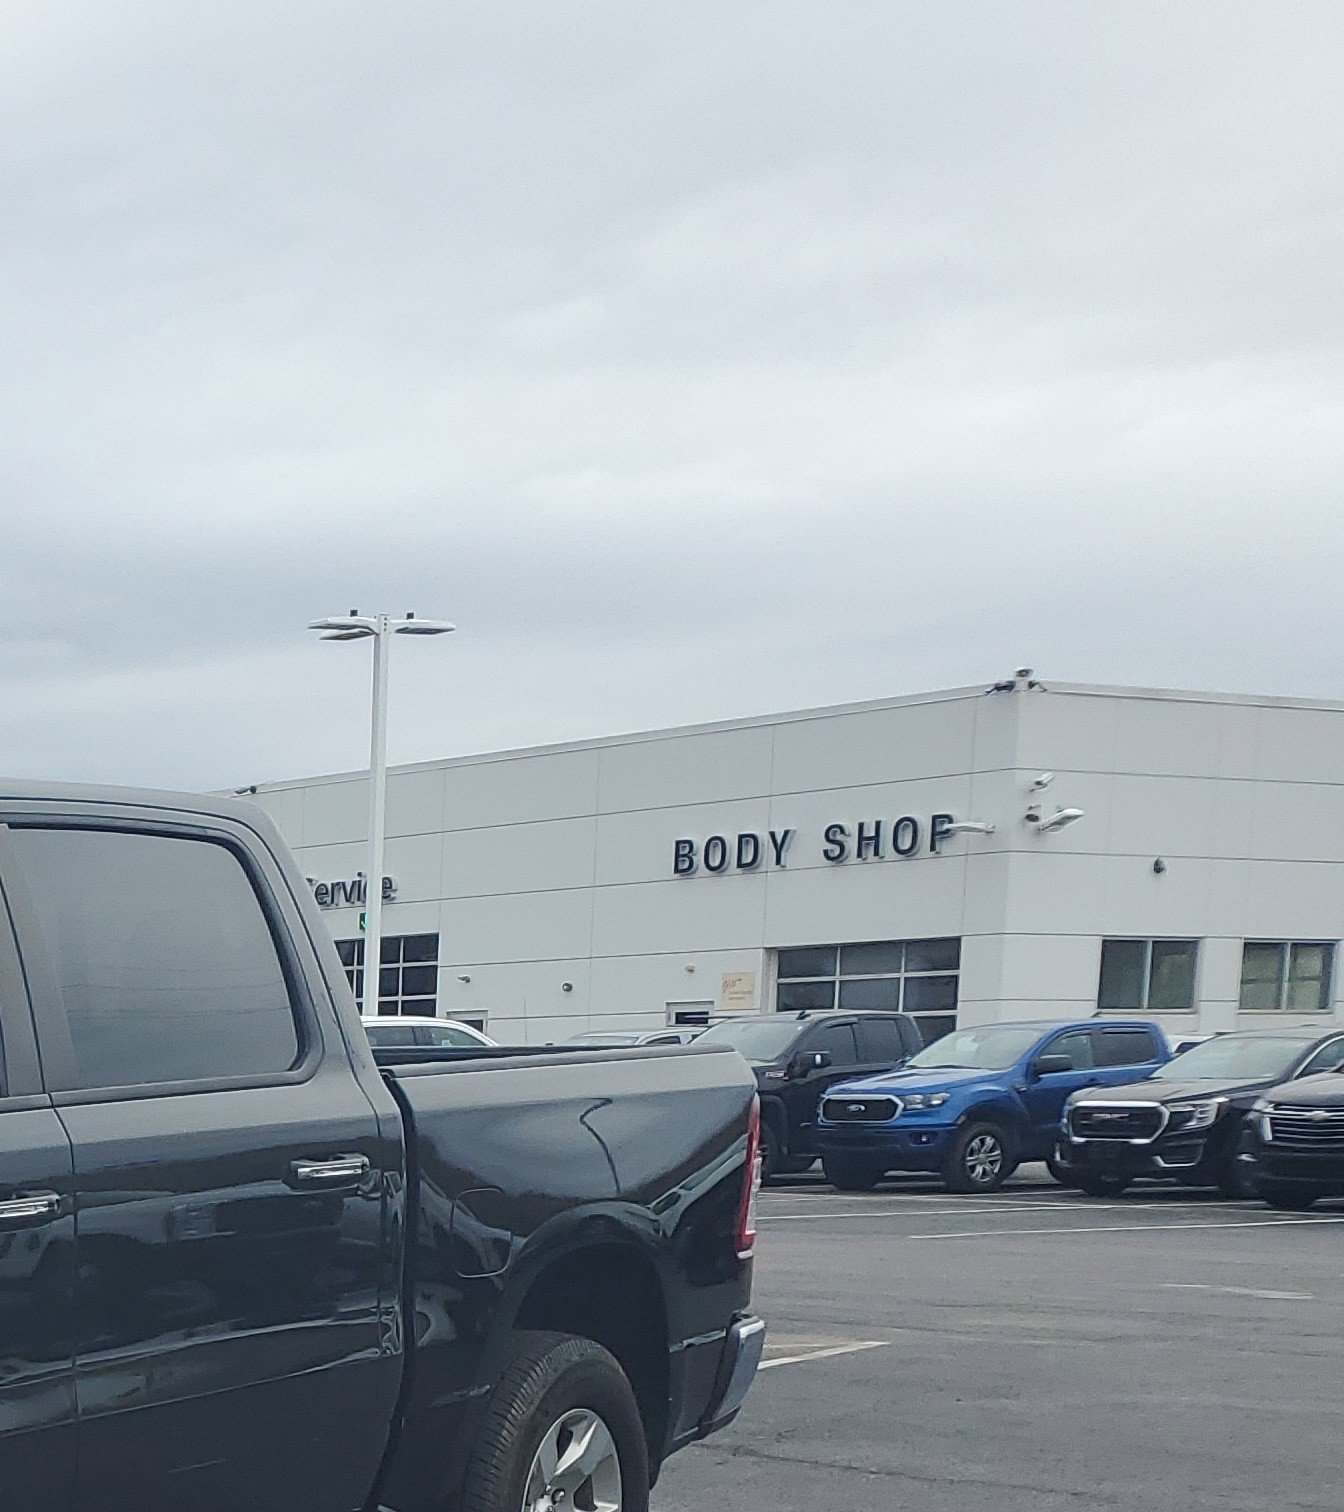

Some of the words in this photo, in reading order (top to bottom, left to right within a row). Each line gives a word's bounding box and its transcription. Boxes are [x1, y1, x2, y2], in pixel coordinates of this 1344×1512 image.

[673, 828, 795, 875] BODY
[823, 813, 955, 862] SHOP
[306, 871, 396, 906] ervie
